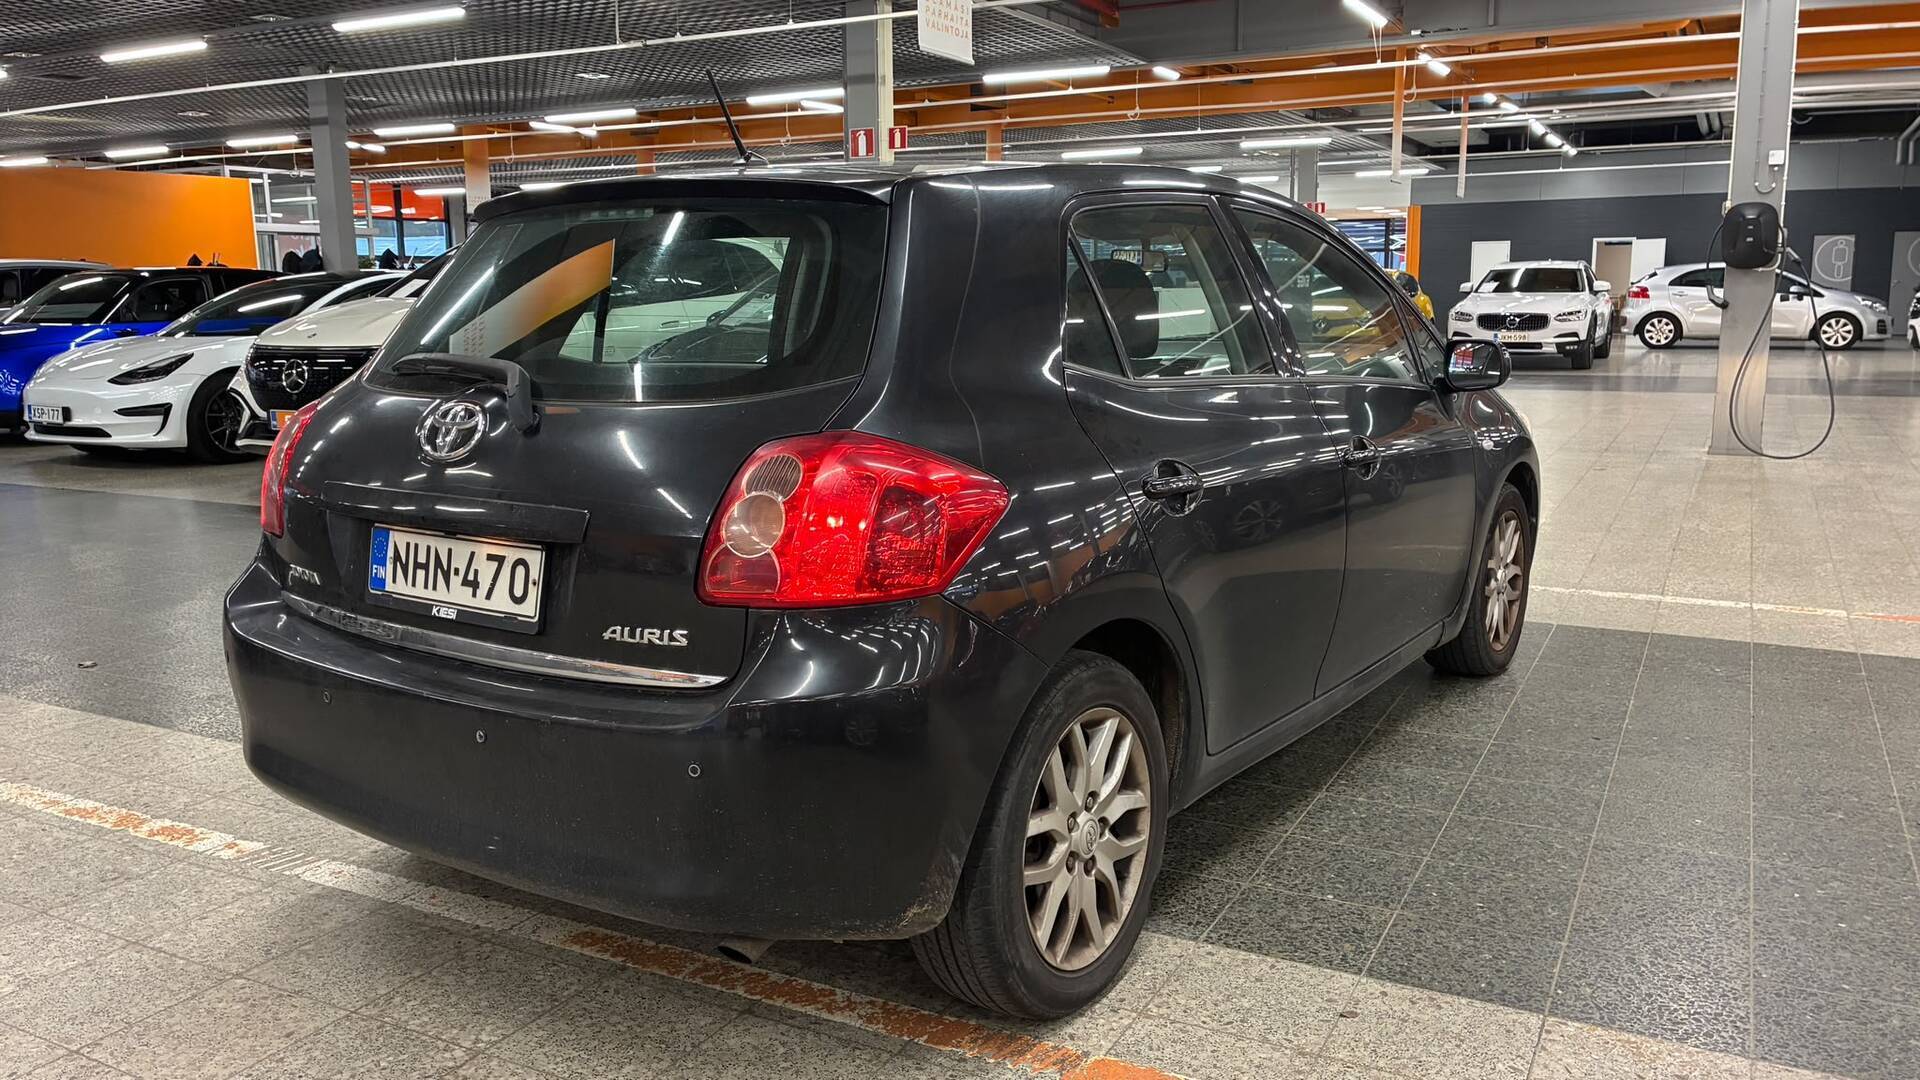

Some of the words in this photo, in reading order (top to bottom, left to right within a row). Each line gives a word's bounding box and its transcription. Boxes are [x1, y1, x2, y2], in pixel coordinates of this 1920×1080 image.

[925, 17, 969, 39] VALINTOJA
[32, 407, 60, 421] XSP-177
[372, 564, 386, 580] FIN
[391, 540, 531, 605] NHN-470
[431, 605, 458, 621] KIESI
[602, 625, 689, 647] AURIS
